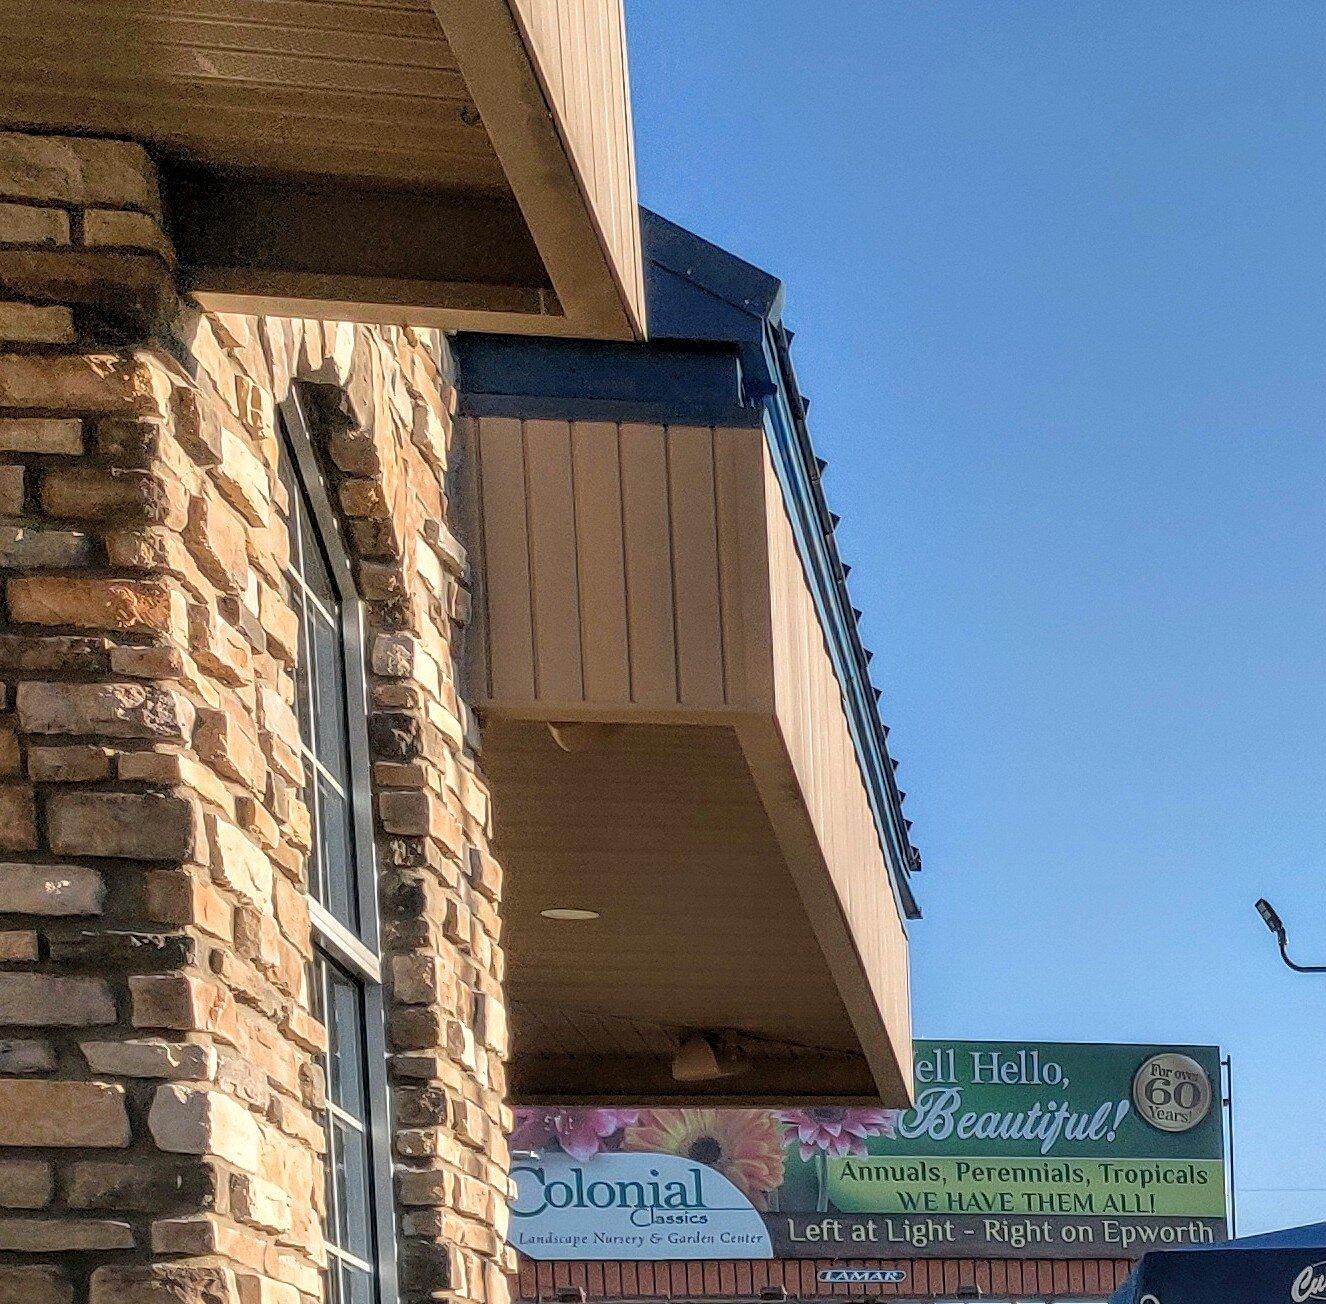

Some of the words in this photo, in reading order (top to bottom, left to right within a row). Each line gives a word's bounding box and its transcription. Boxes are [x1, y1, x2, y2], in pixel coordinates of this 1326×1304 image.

[914, 1048, 959, 1083] ell
[969, 1050, 1070, 1090] Hello,
[1150, 1063, 1173, 1078] For
[1144, 1077, 1201, 1110] 60
[899, 1086, 1131, 1156] Beautiful!
[1148, 1105, 1193, 1124] Years!
[839, 1160, 948, 1186] Annuals,
[956, 1161, 1091, 1188] Perennials,
[1097, 1163, 1209, 1188] Tropicals
[506, 1166, 707, 1218] Colonial
[897, 1191, 939, 1212] WE
[948, 1192, 1015, 1213] HAVE
[1021, 1192, 1094, 1213] THEM
[1102, 1193, 1156, 1214] ALL!
[630, 1207, 708, 1228] Classics
[519, 1231, 589, 1248] Landscape
[592, 1231, 646, 1248] Nursery
[649, 1232, 664, 1244] &
[667, 1230, 715, 1245] Garden
[719, 1231, 764, 1245] Center
[787, 1217, 845, 1243] Left
[852, 1220, 879, 1243] at
[887, 1219, 957, 1248] Light
[984, 1219, 1054, 1249] Right
[1061, 1224, 1094, 1243] on
[1102, 1220, 1215, 1249] Epworth
